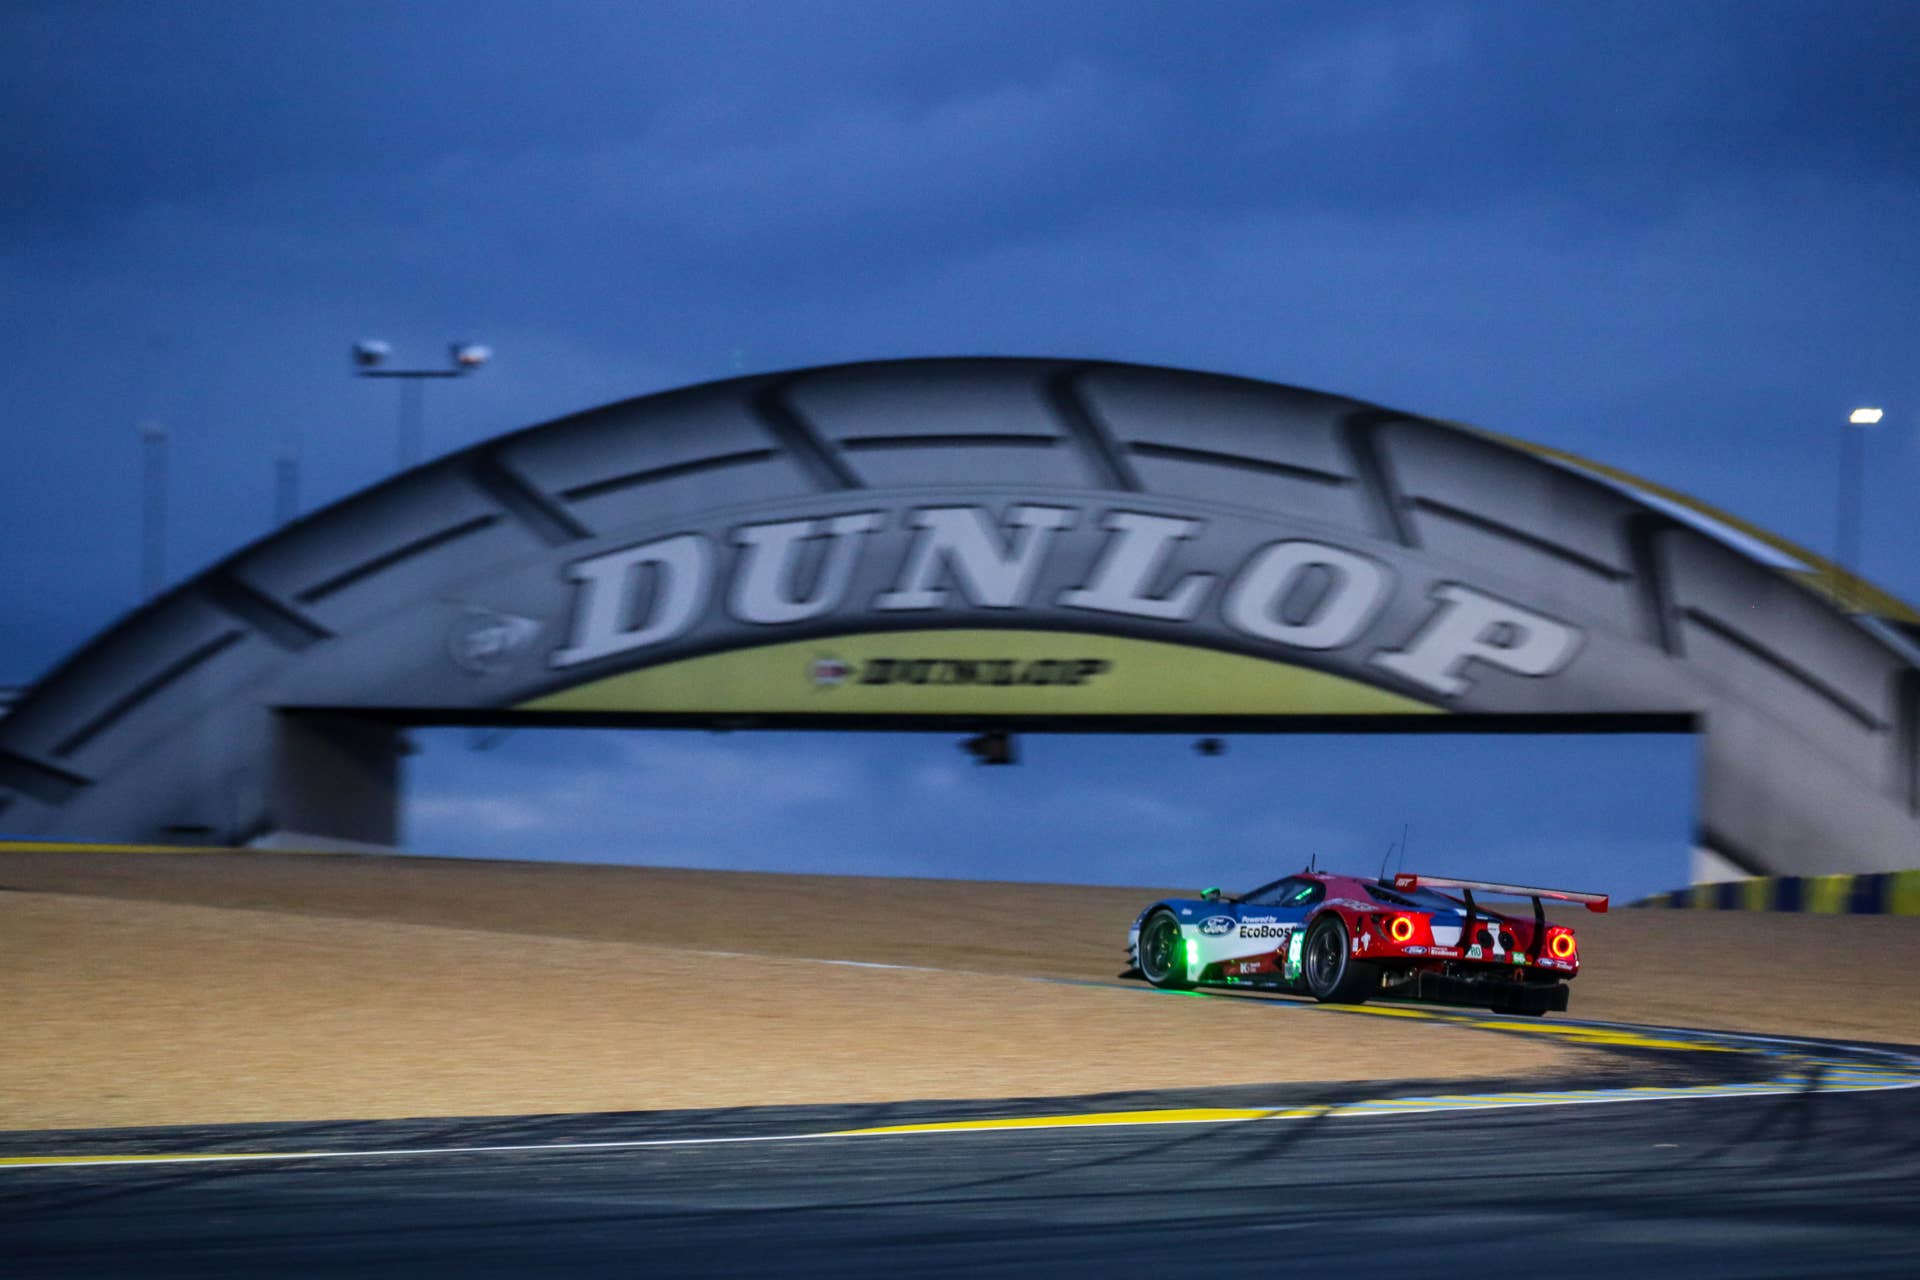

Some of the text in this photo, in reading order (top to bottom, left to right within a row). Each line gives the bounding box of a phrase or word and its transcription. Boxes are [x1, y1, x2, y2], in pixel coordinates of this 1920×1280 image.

[549, 504, 1585, 698] DUNLOP
[860, 658, 1110, 686] DUNLOP
[1204, 918, 1230, 934] Ford
